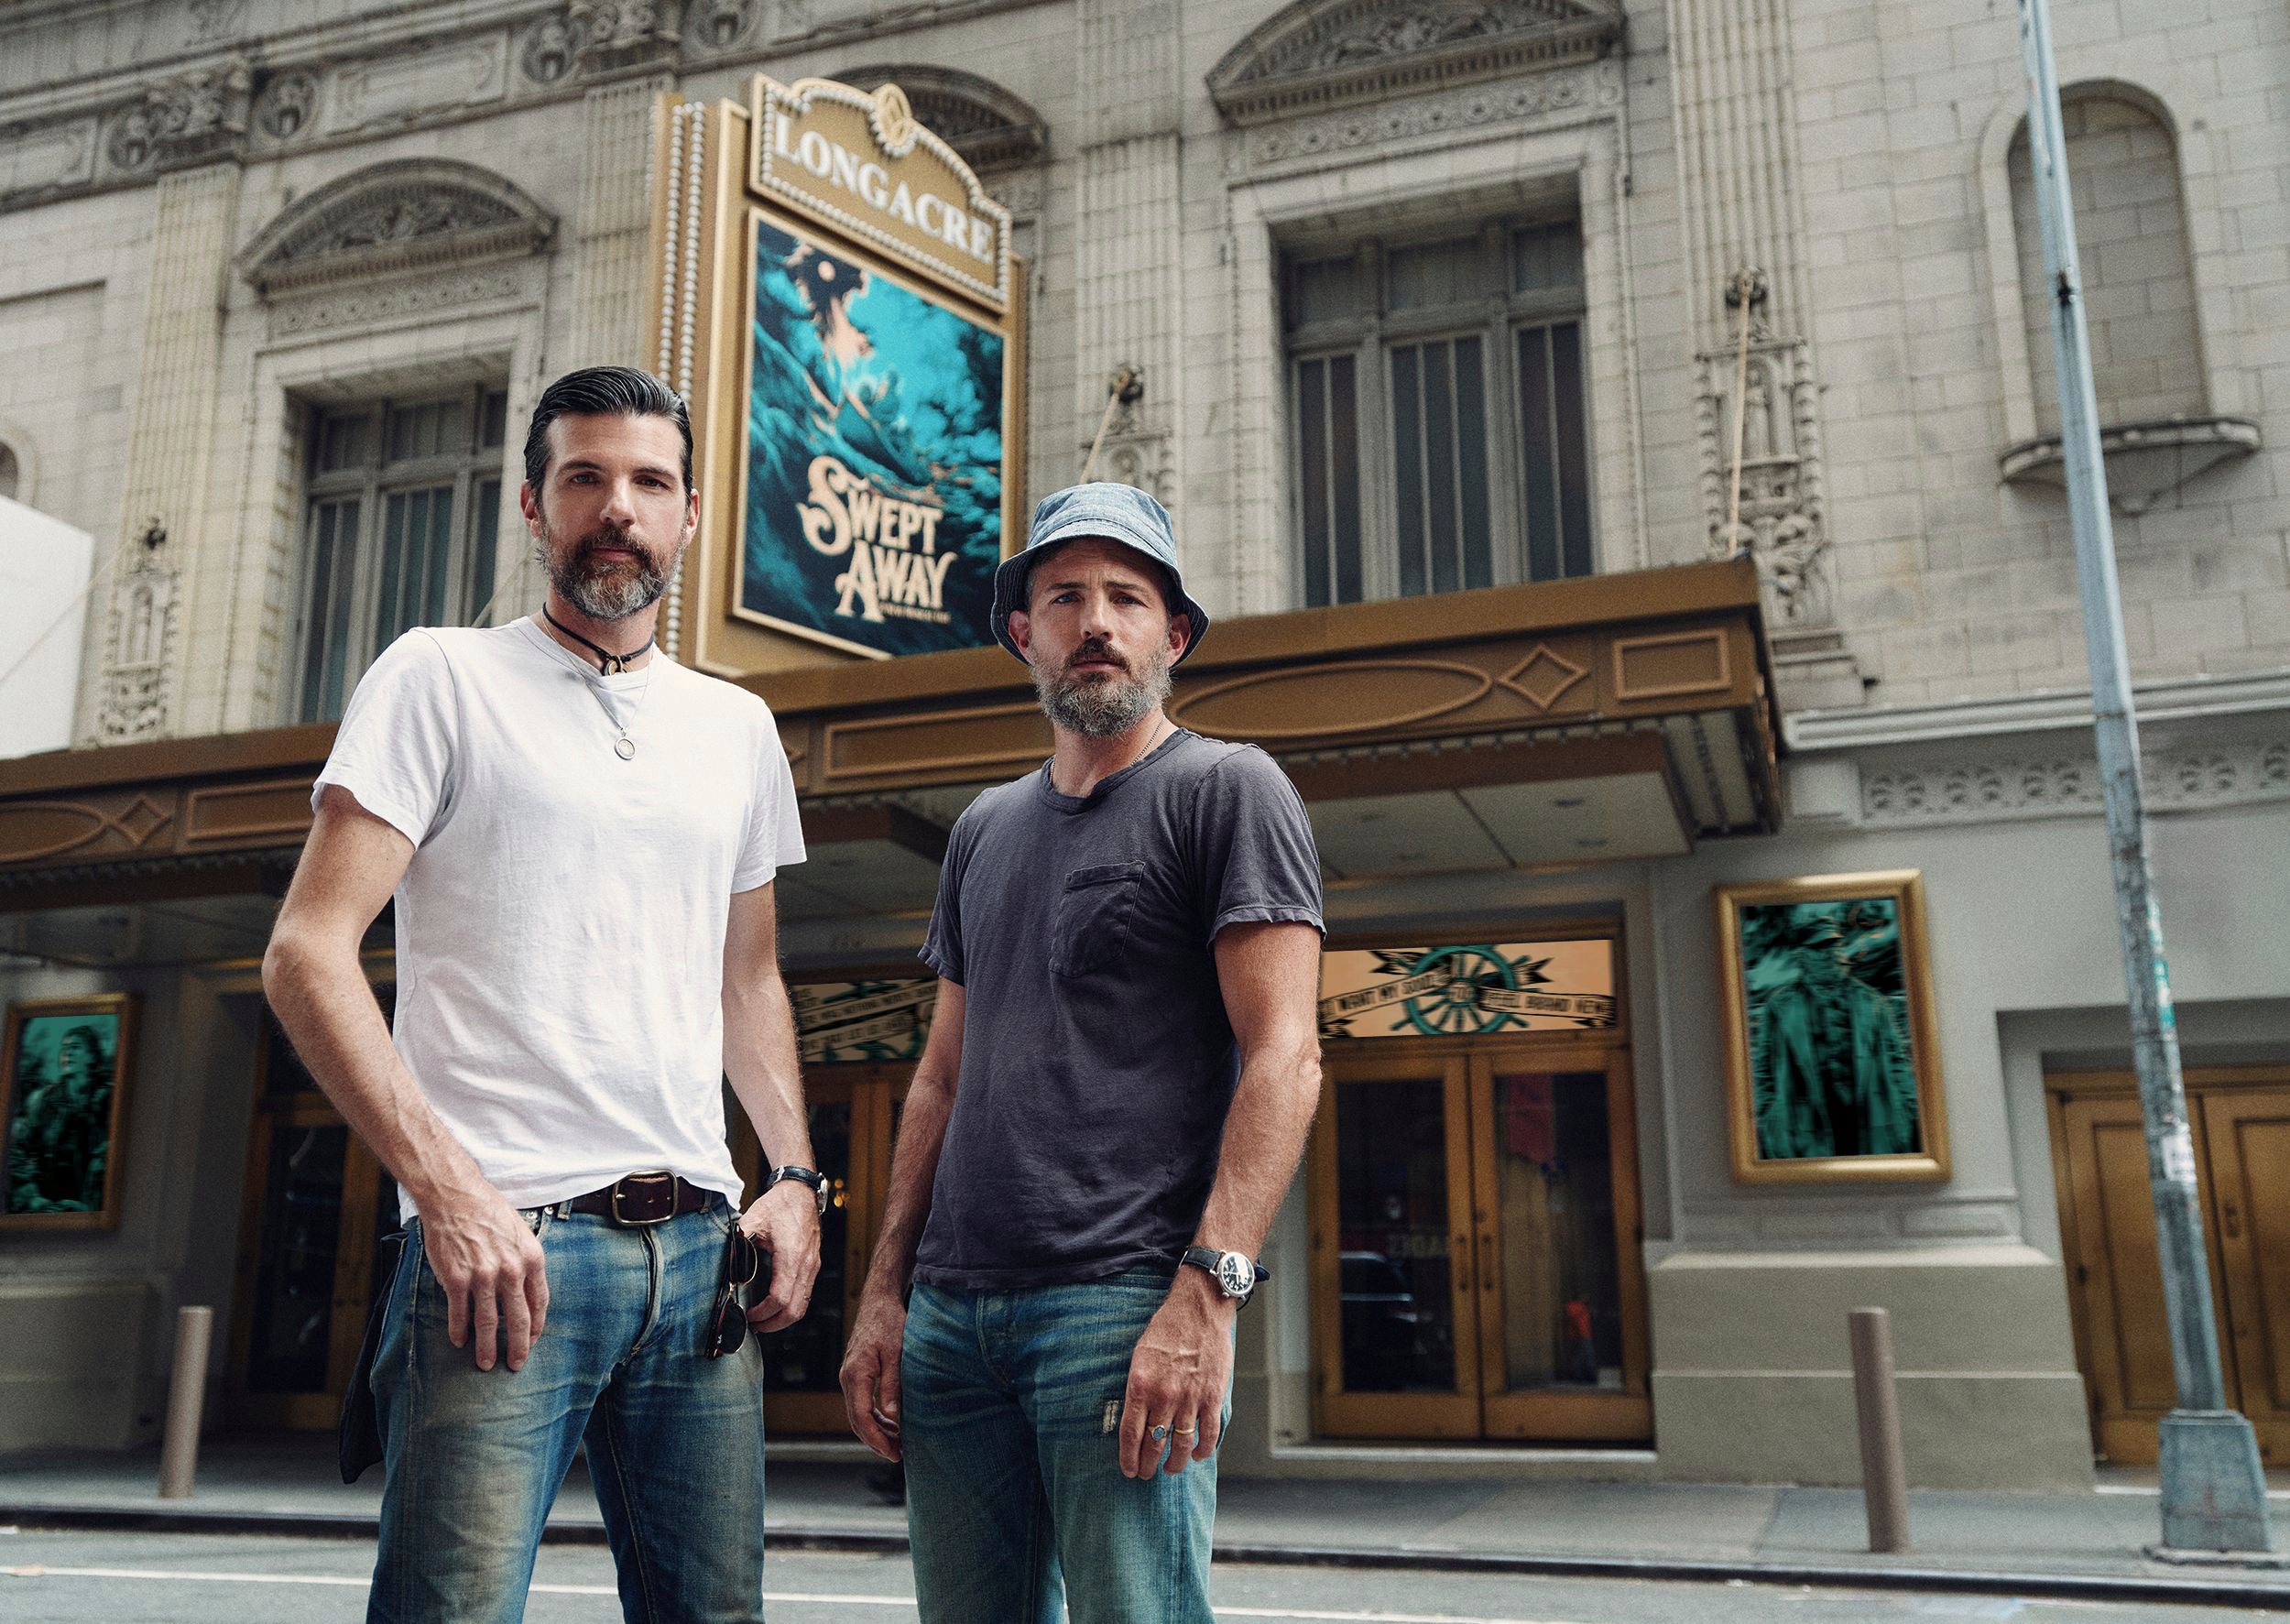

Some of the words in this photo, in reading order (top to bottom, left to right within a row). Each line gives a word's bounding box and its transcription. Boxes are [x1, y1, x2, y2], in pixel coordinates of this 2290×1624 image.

[775, 113, 993, 264] LONGACRE
[796, 455, 943, 556] SWEPT
[834, 539, 958, 623] AWAY
